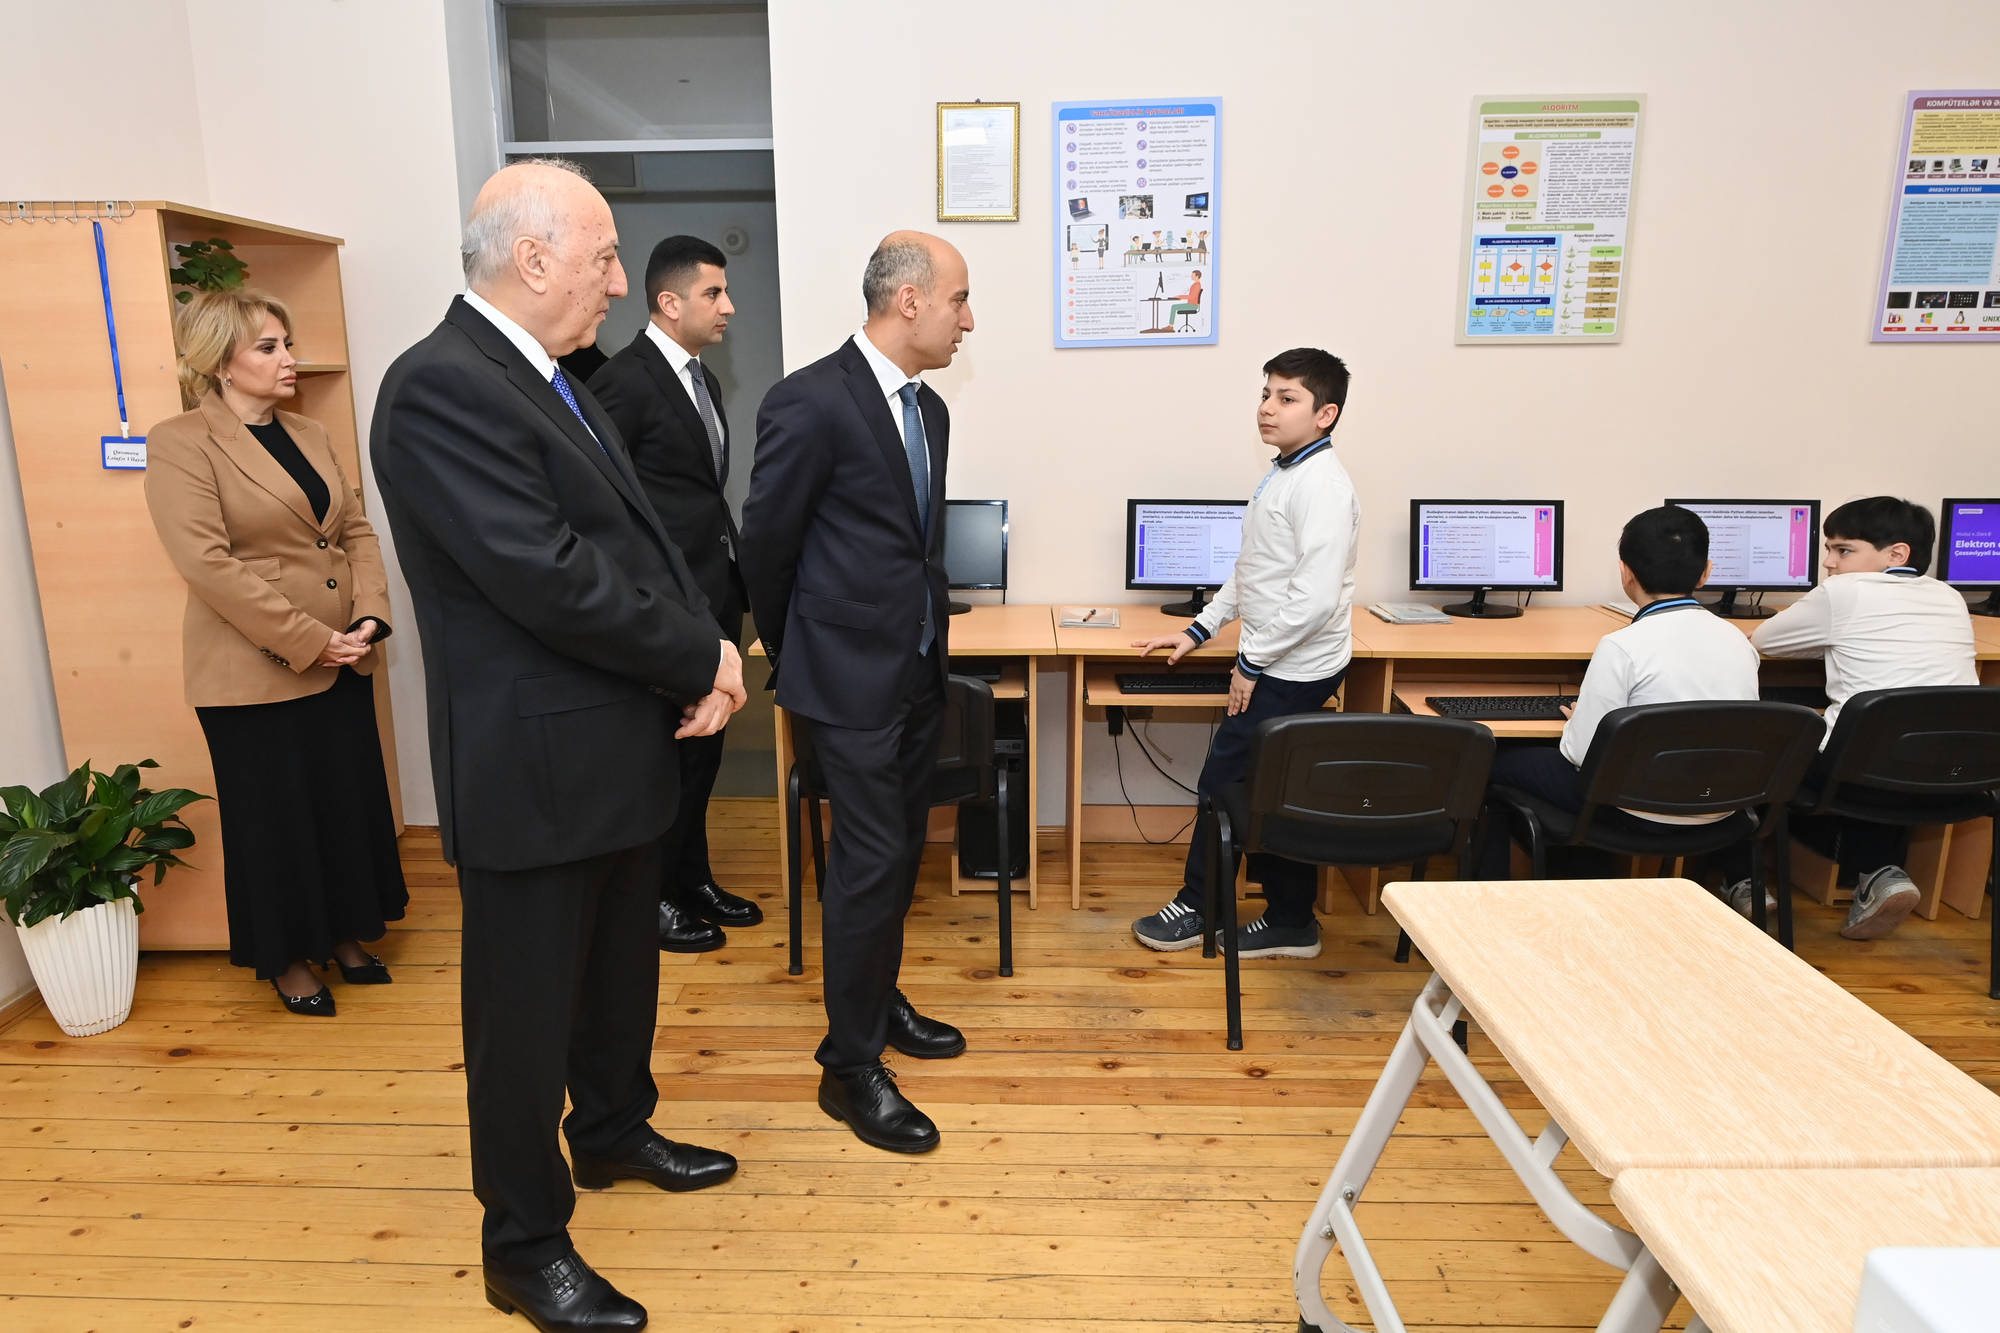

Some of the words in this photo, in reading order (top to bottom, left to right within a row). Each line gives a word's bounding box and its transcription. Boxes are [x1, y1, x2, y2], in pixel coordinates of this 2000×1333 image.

[1955, 540, 1996, 548] Elektron
[1699, 787, 1711, 797] 3
[1362, 798, 1372, 807] 2
